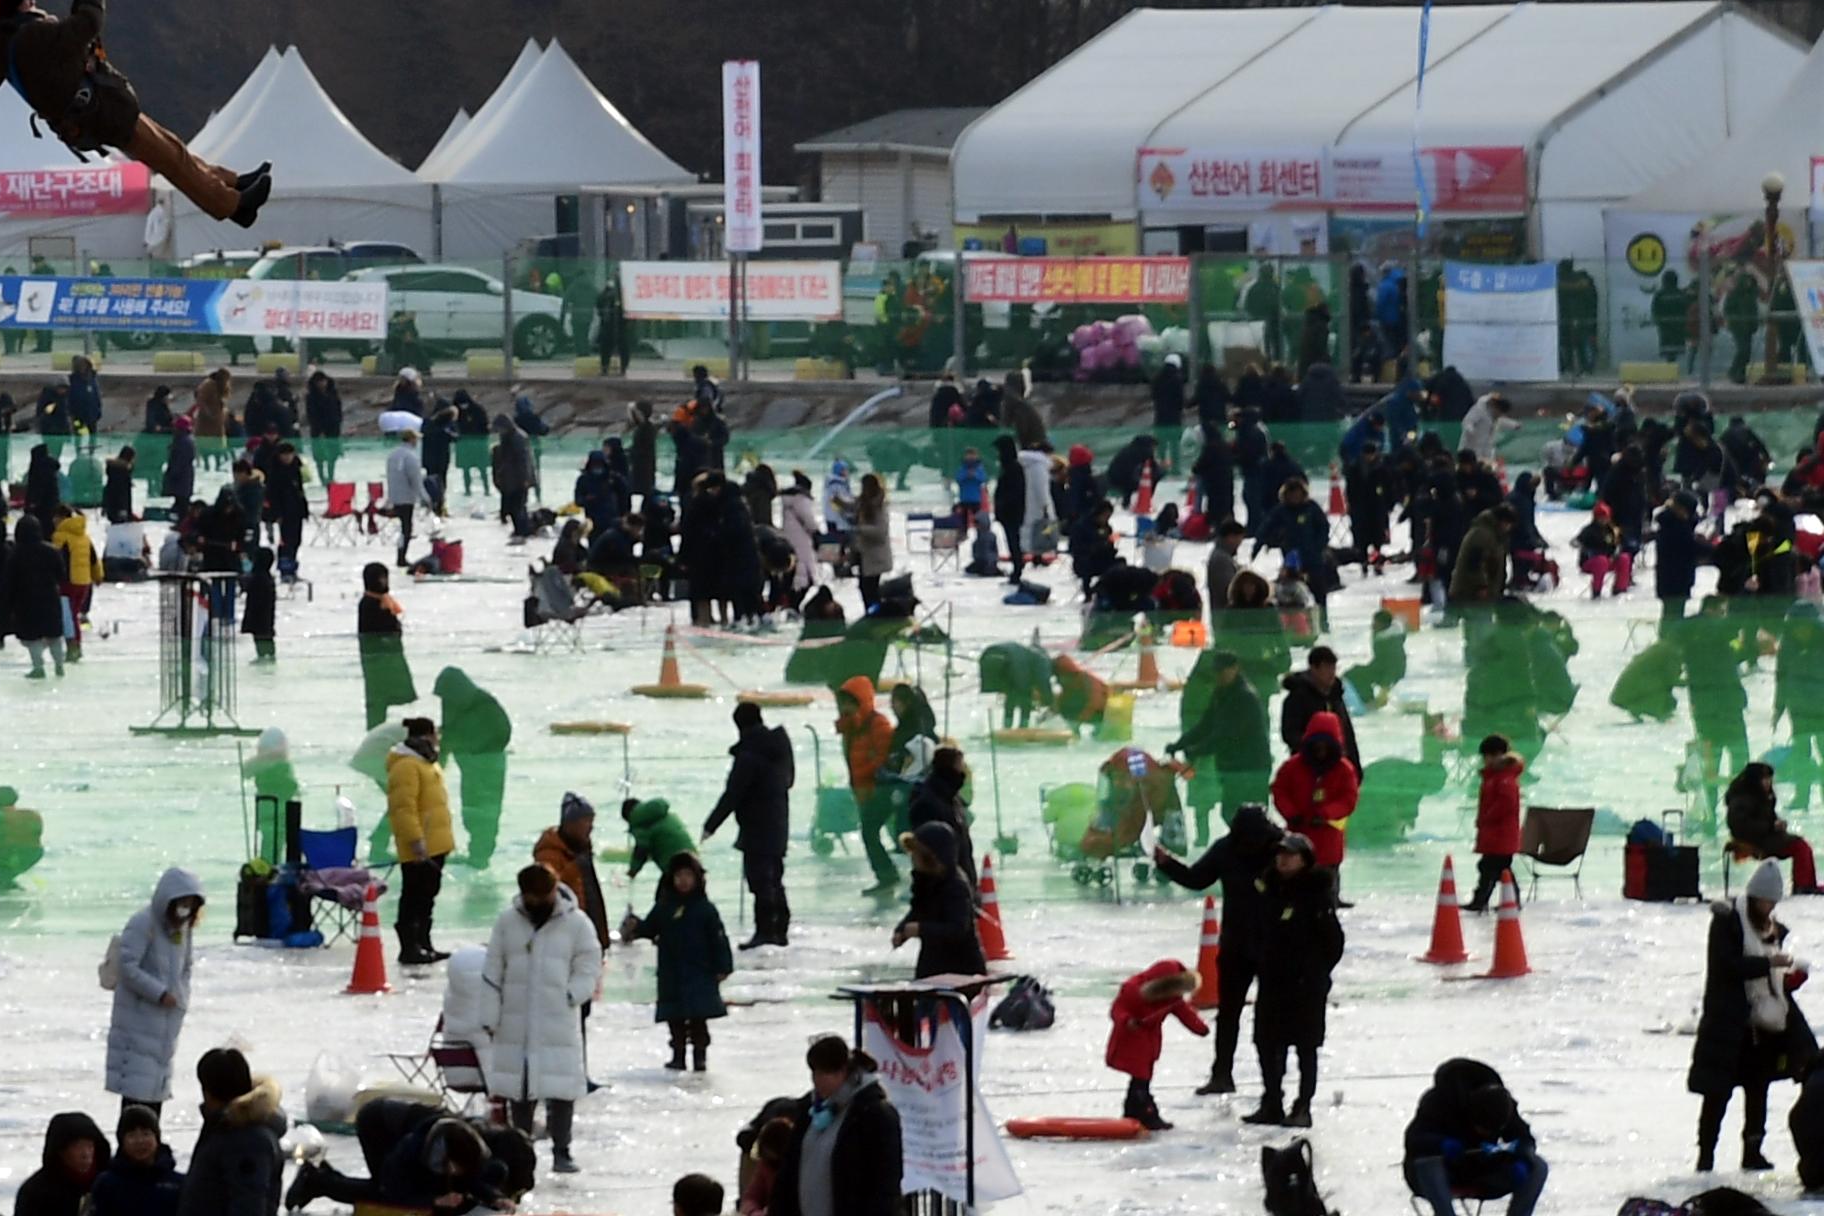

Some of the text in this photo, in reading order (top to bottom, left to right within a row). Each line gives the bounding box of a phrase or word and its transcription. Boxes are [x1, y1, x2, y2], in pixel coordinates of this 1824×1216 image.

[7, 170, 123, 200] 재난구조대
[1188, 160, 1251, 196] 산천어
[1258, 160, 1322, 196] 회센터
[111, 298, 148, 315] 사용해
[149, 299, 191, 316] 주세요!
[264, 308, 292, 330] 절대
[328, 311, 379, 331] 마세요!
